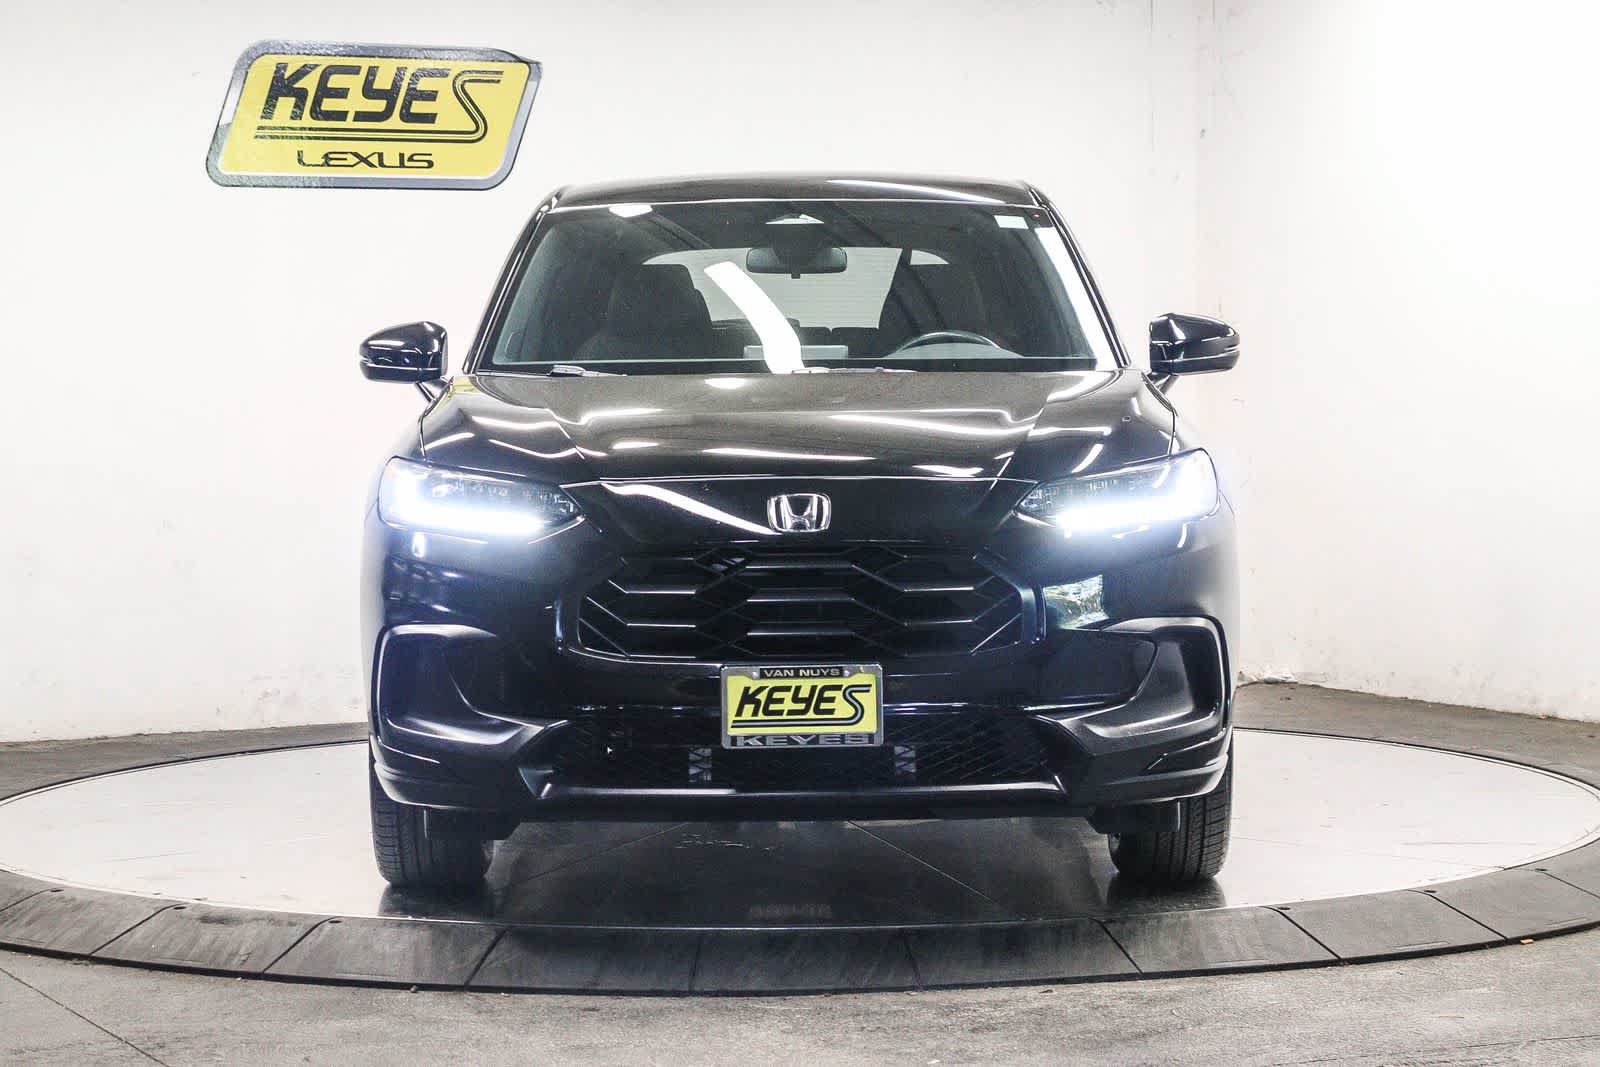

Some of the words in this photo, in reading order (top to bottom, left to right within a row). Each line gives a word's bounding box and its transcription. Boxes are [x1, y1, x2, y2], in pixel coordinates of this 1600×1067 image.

[255, 62, 504, 143] KEYES
[297, 150, 434, 168] LEXUS
[764, 668, 794, 677] VAN
[799, 668, 840, 677] NUYS
[731, 684, 872, 728] KEYES
[736, 735, 869, 746] KEYES
